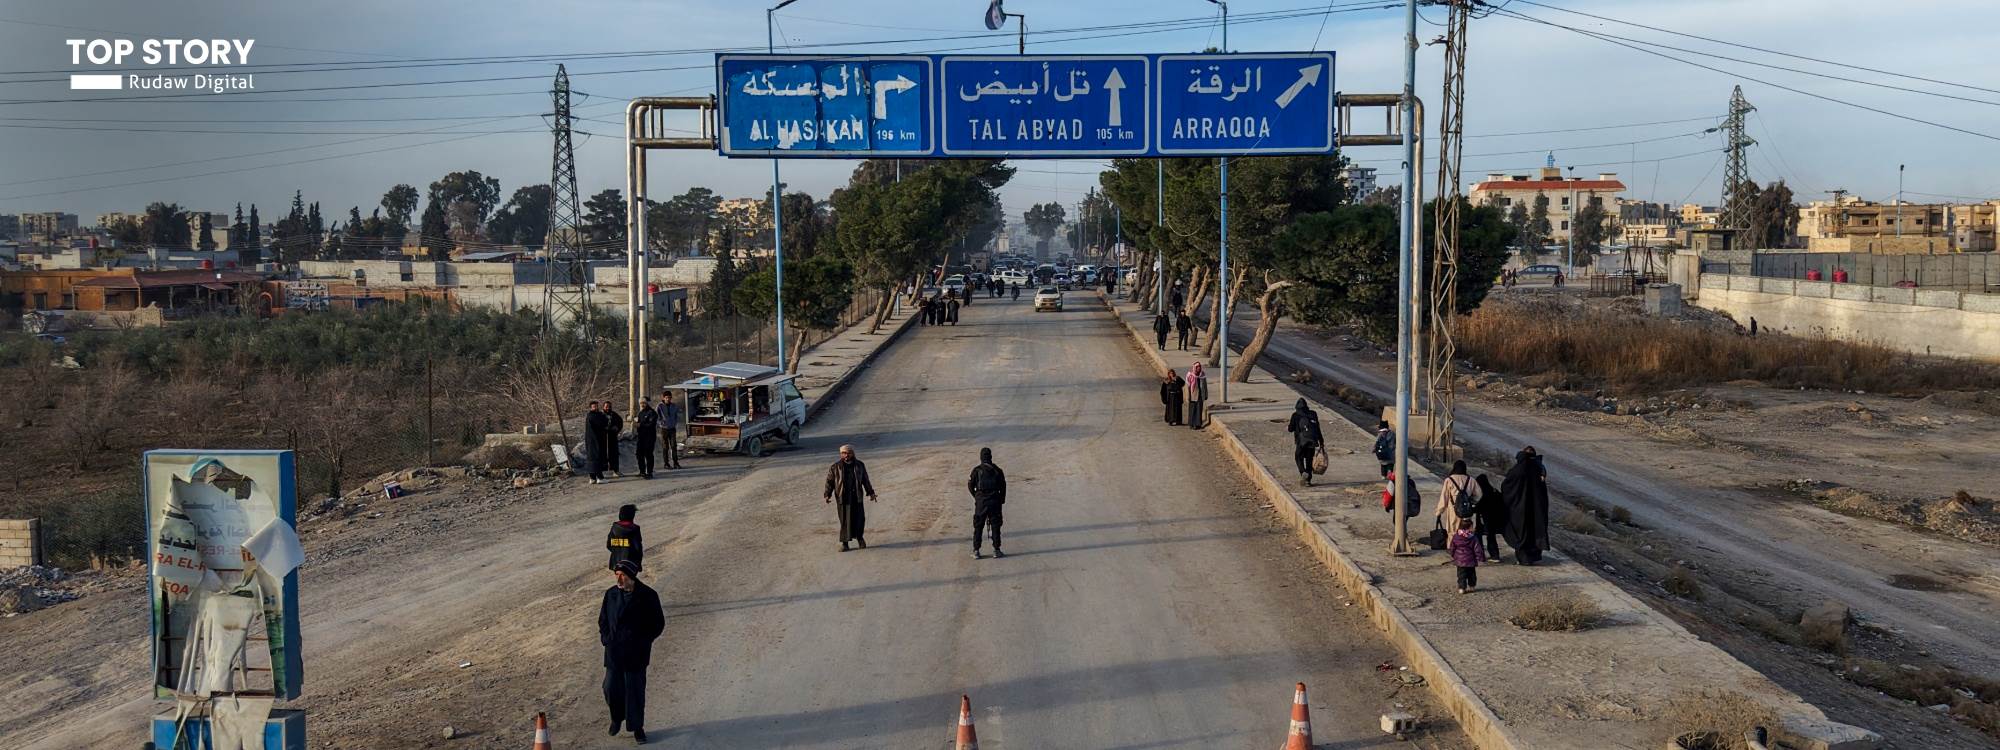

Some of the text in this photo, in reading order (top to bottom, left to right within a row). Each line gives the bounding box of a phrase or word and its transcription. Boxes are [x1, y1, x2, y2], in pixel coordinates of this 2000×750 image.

[959, 61, 1091, 105] تل أبيض
[1187, 65, 1262, 102] الرقة
[900, 129, 916, 140] km
[969, 118, 1083, 140] TAL ABYAD
[1096, 128, 1134, 140] 105 km
[1172, 116, 1271, 139] ARRAQQA
